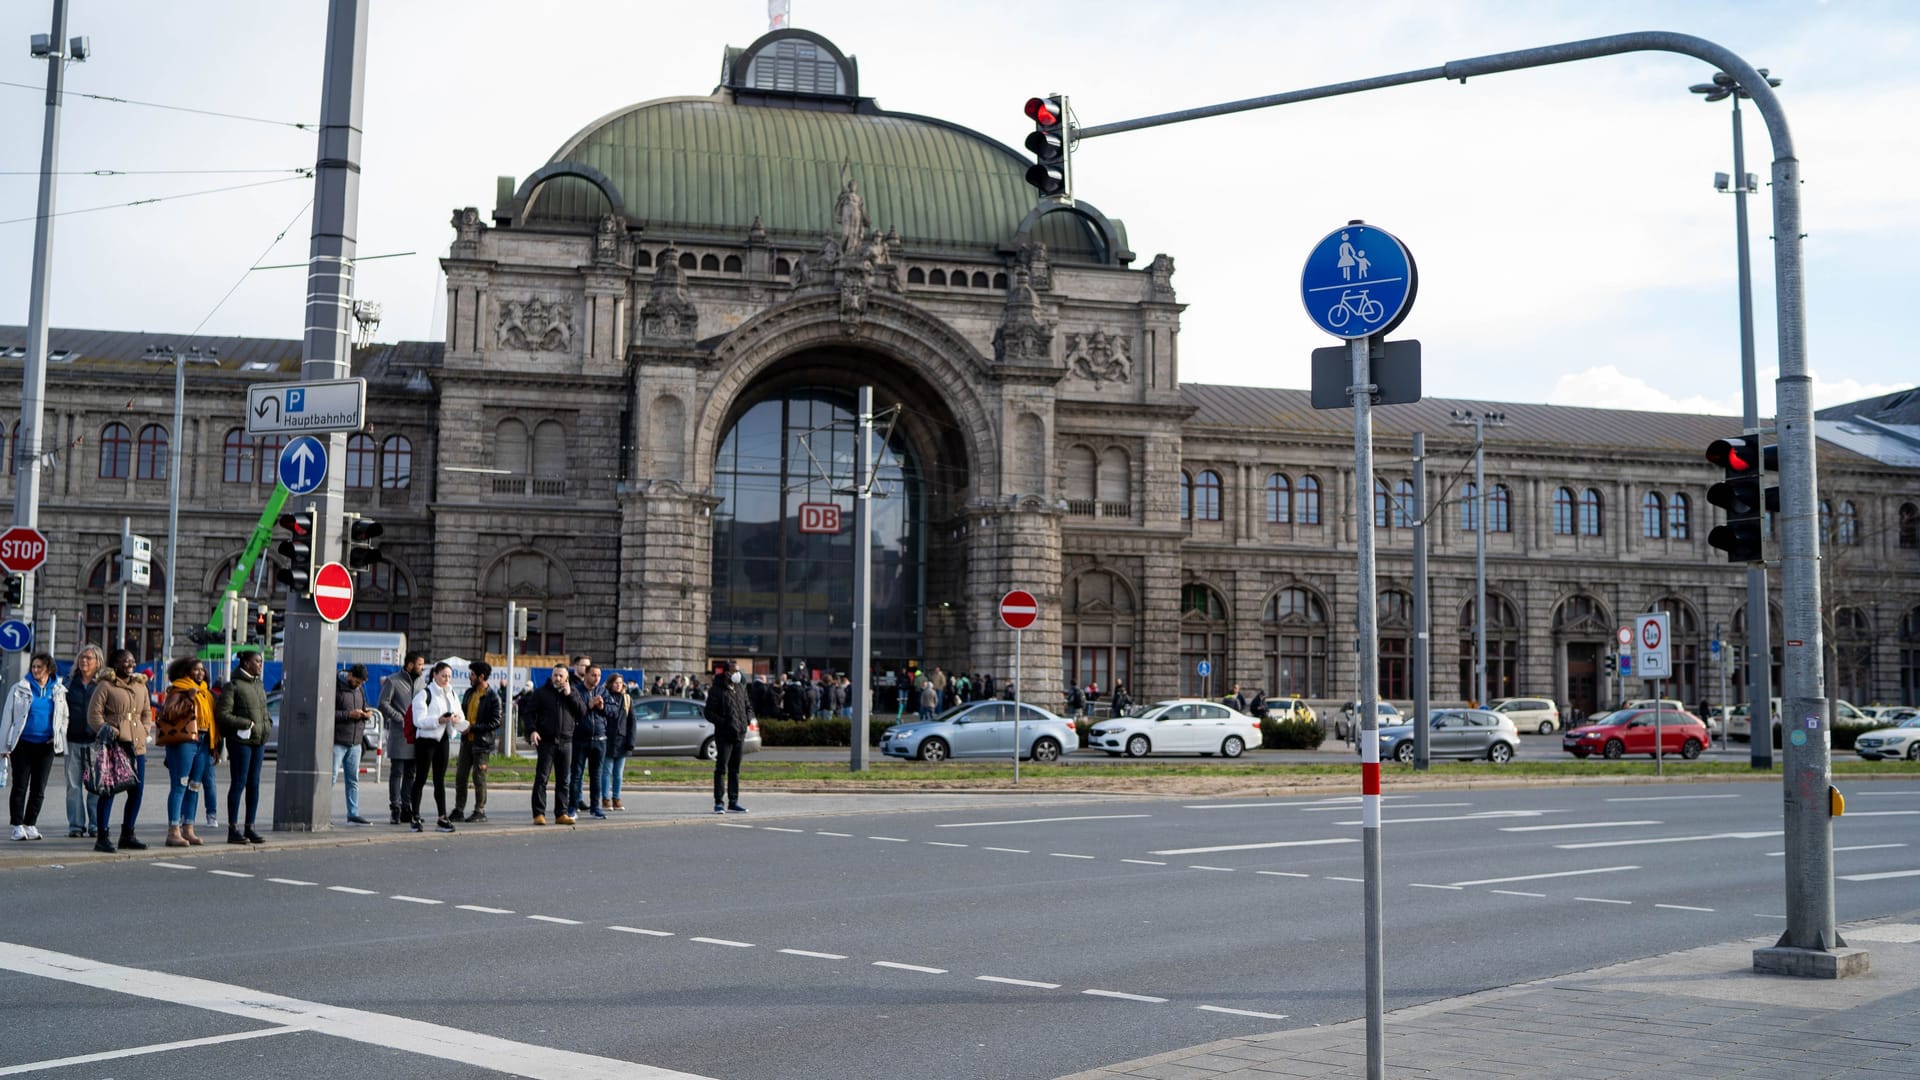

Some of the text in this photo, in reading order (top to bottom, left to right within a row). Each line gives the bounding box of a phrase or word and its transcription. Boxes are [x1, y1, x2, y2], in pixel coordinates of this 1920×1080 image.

[289, 391, 301, 410] P
[284, 411, 357, 428] Hauptbahnhof
[806, 509, 836, 528] DB
[1, 540, 42, 560] STOP
